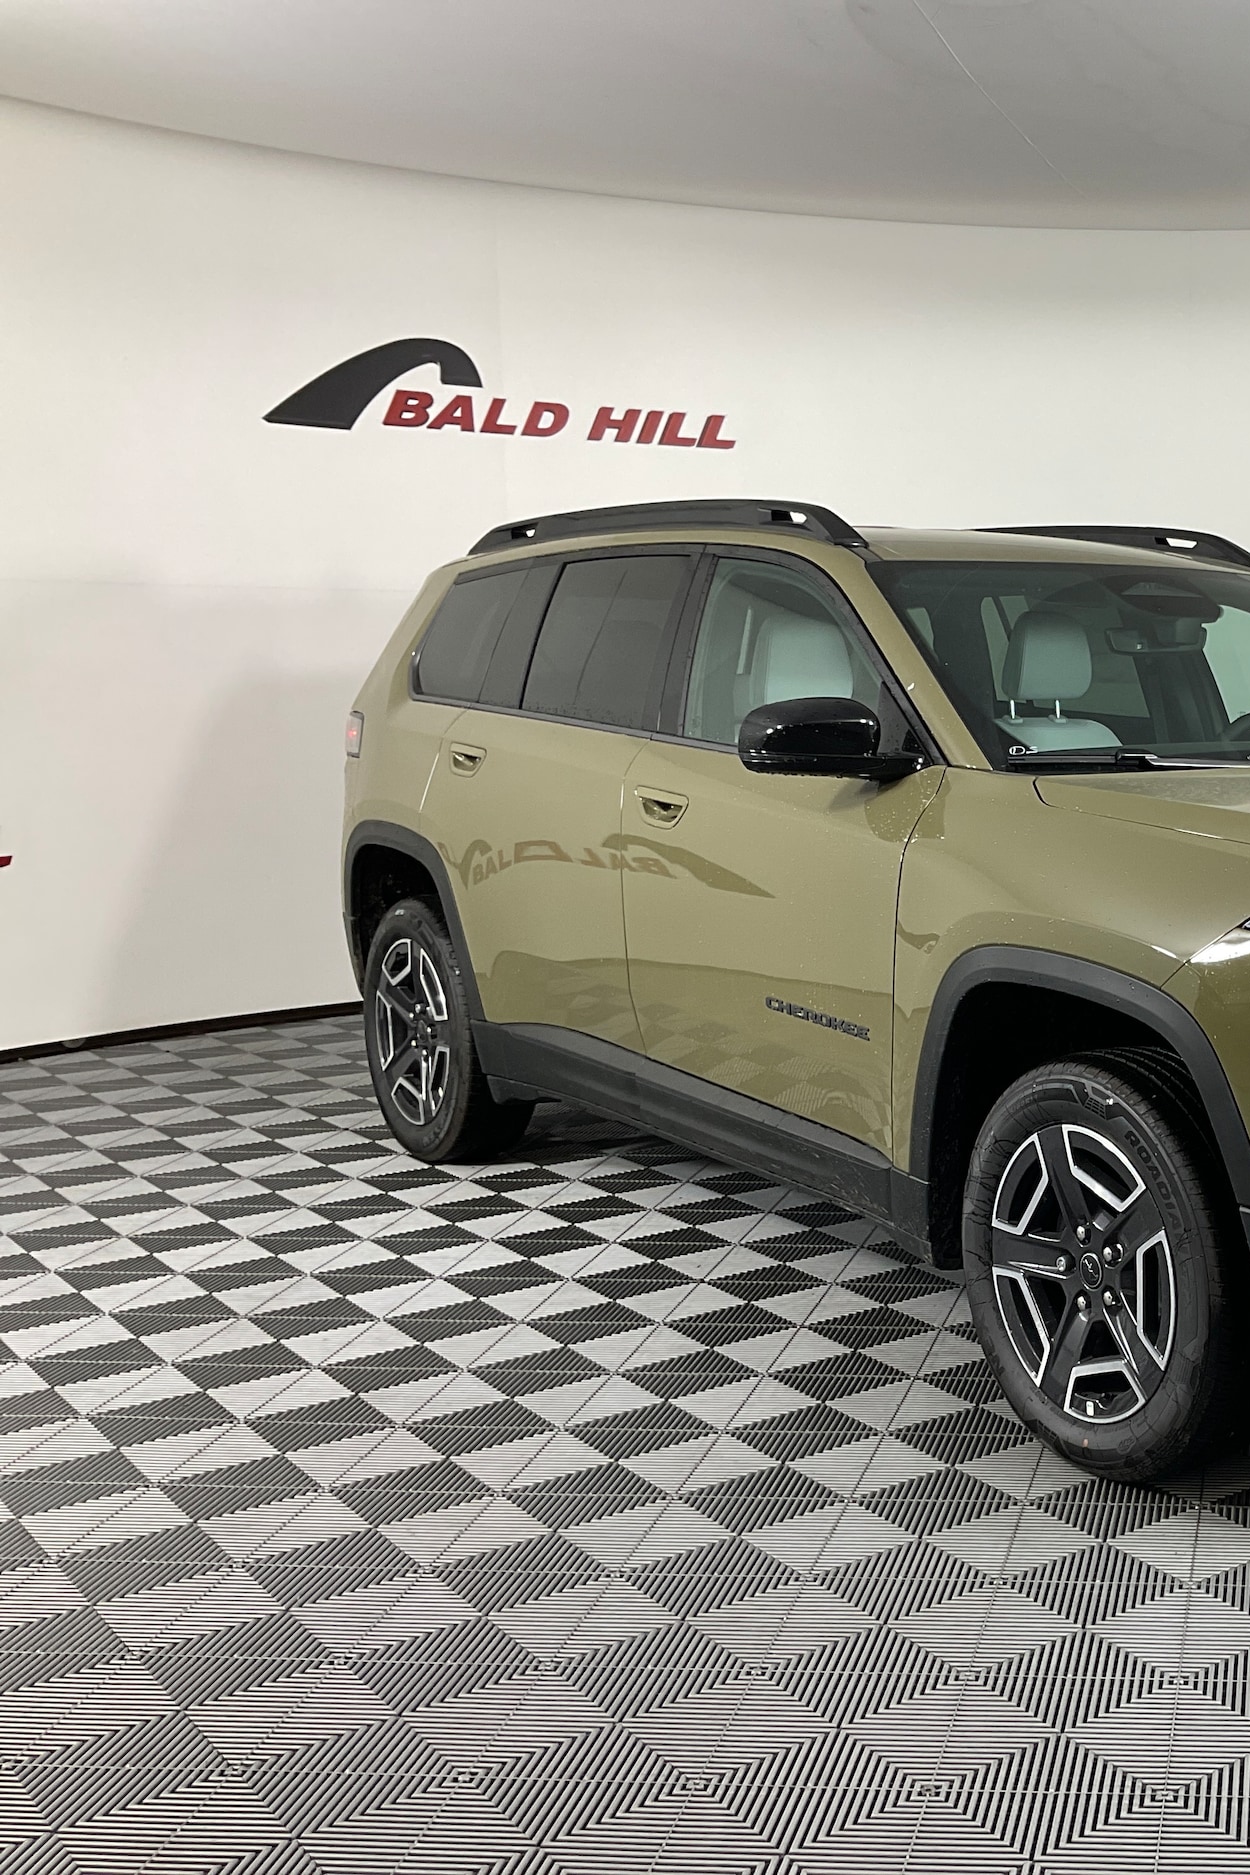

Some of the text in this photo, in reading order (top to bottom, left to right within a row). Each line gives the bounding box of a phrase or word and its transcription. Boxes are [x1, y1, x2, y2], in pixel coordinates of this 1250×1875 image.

[382, 389, 736, 450] BALD HILL
[765, 996, 871, 1042] CHEROKEE
